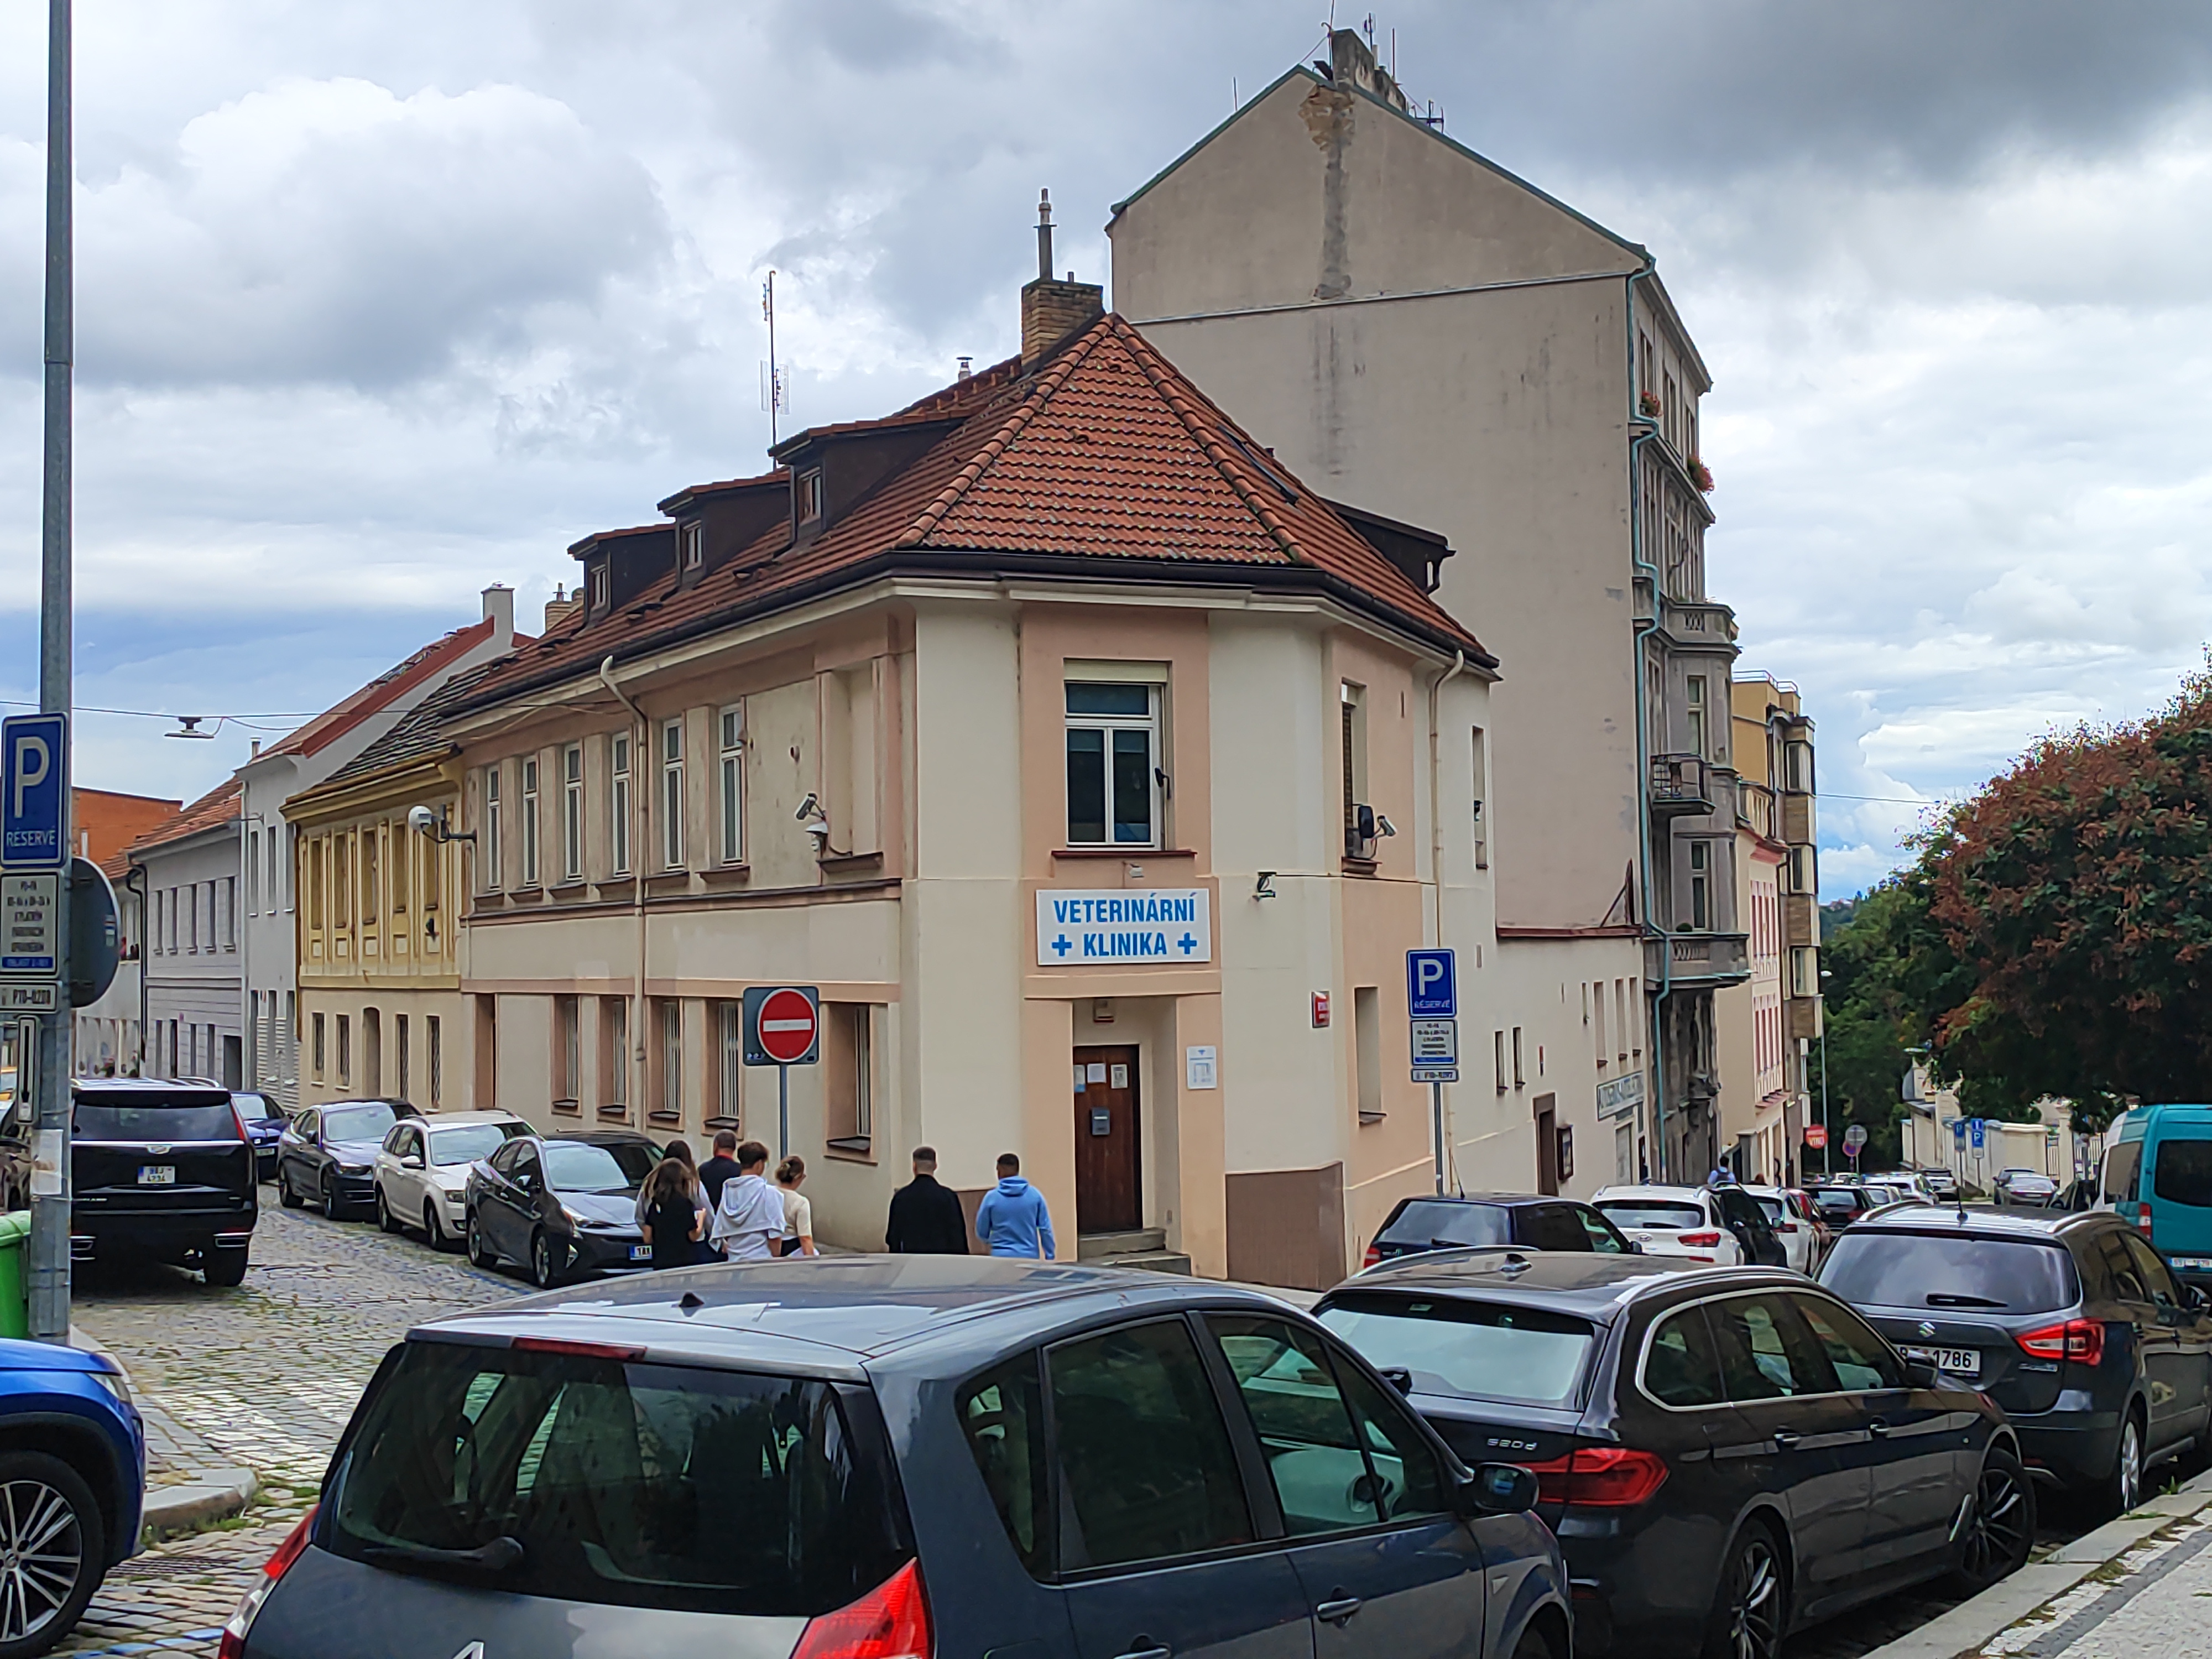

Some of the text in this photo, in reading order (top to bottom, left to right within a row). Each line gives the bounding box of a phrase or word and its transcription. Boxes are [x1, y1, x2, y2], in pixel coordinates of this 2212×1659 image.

[14, 737, 49, 818] P
[1053, 892, 1197, 924] VETERINÁRNÍ
[1083, 932, 1167, 957] KLINIKA
[1417, 959, 1443, 996] P
[1933, 1350, 1972, 1368] 1786
